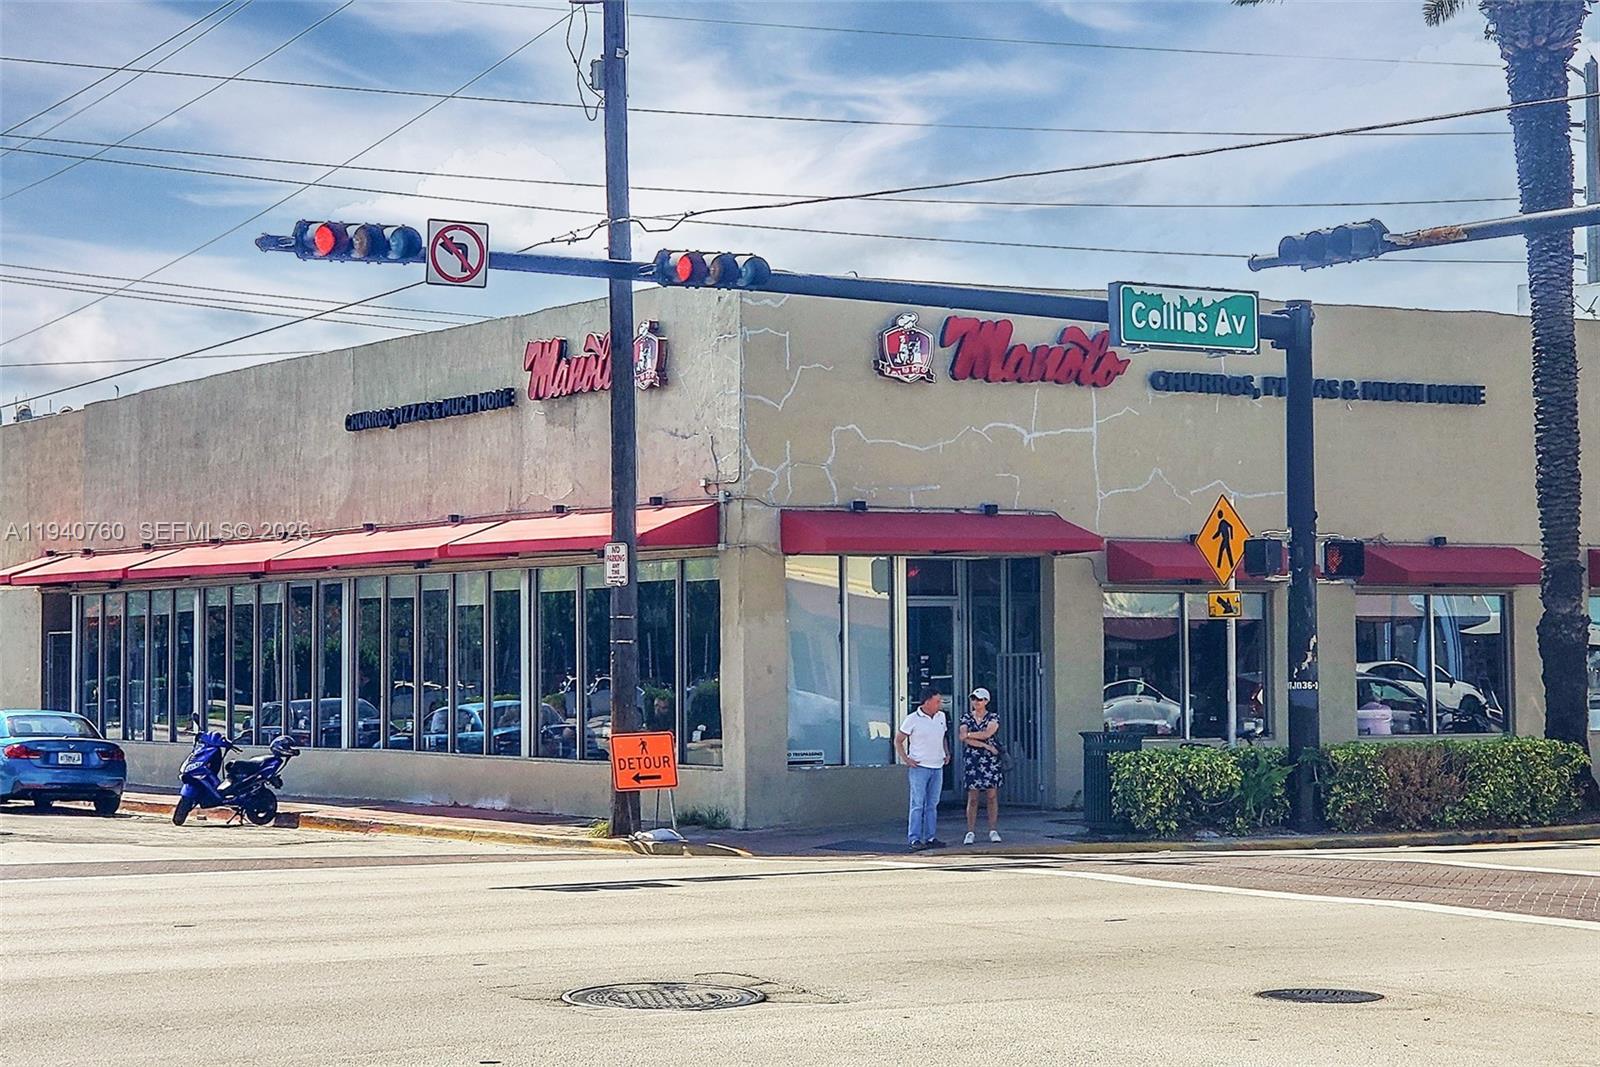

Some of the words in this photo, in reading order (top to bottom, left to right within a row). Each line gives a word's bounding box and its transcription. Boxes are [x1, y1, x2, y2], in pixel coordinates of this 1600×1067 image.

[1131, 301, 1209, 333] Collins
[1215, 307, 1247, 337] Av
[1149, 371, 1261, 399] CHURROS,
[1262, 376, 1340, 399] PIAS
[1341, 380, 1359, 400] &
[1360, 381, 1425, 402] MUCH
[1426, 384, 1486, 404] MORE
[394, 402, 430, 428] PIZZAS
[431, 402, 441, 418] &
[441, 395, 475, 417] MUCH
[477, 388, 516, 412] MORE
[607, 554, 626, 562] PARKING
[611, 546, 621, 554] NO
[618, 755, 671, 770] DETOUR
